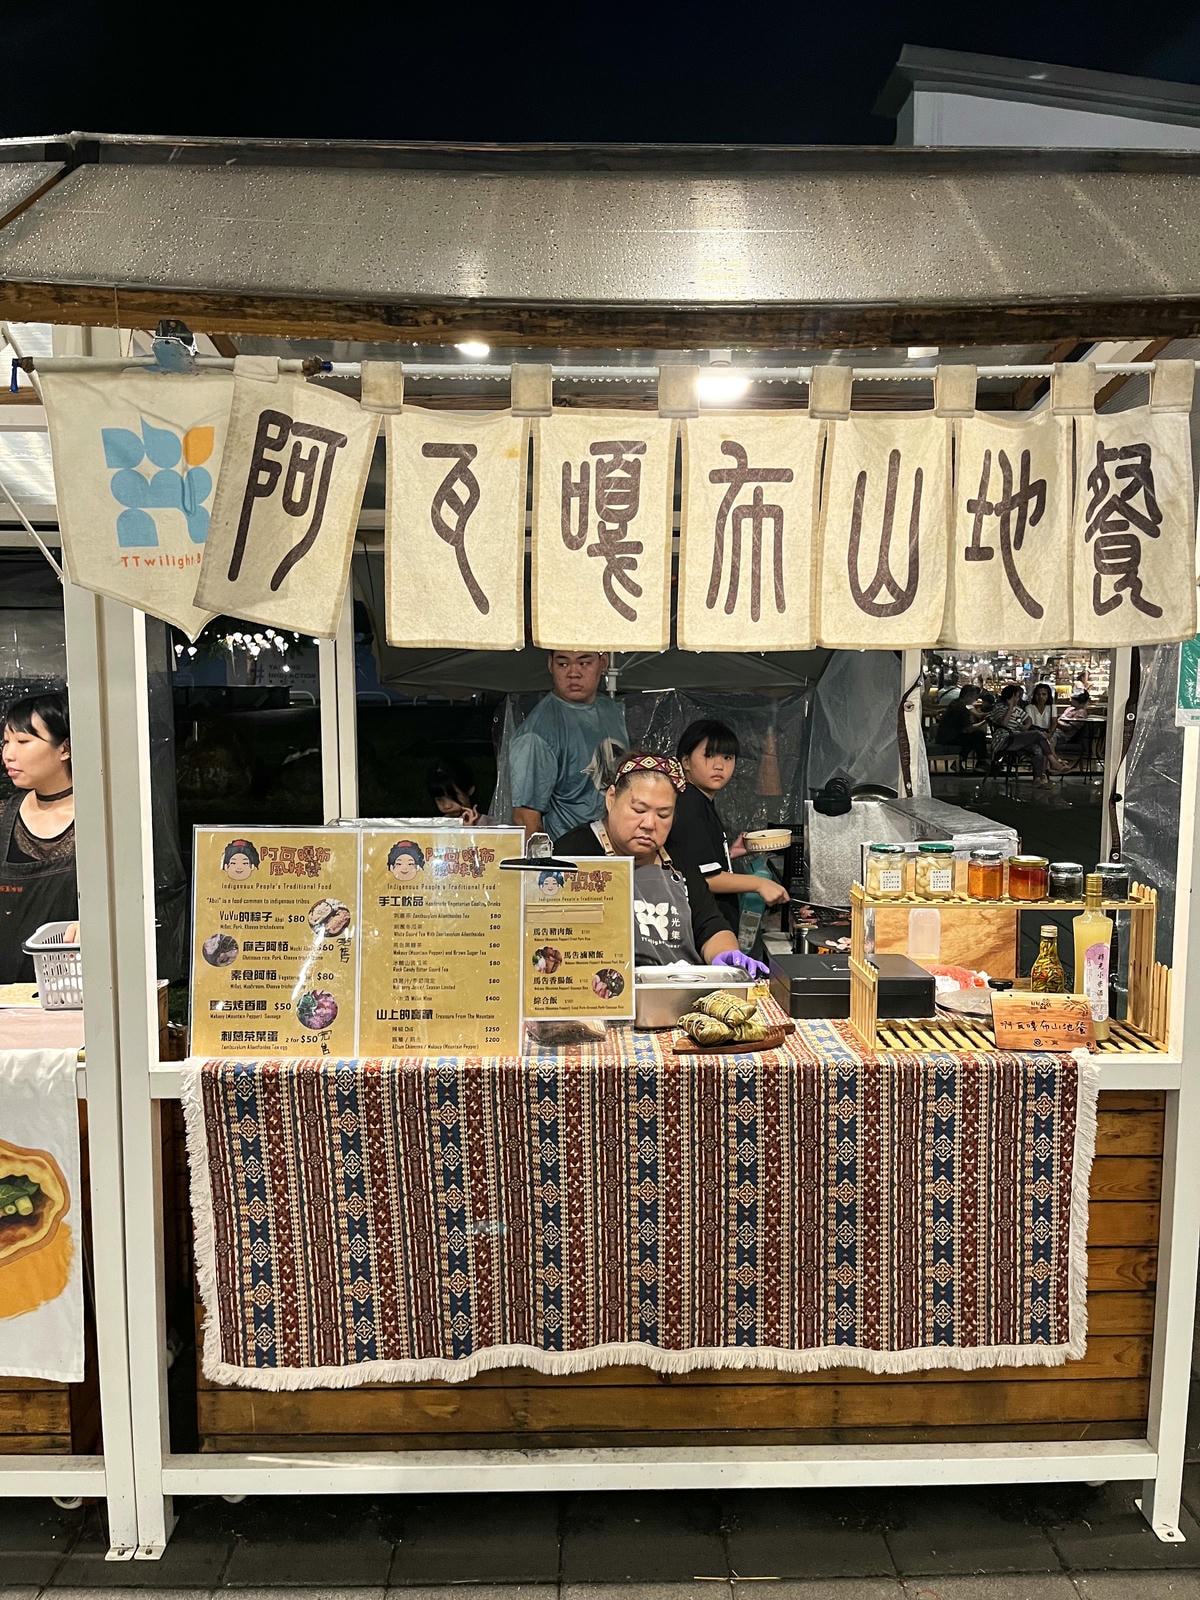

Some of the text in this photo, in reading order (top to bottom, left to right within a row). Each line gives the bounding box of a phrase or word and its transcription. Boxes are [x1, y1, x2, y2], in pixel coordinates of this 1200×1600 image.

[232, 897, 243, 905] food
[243, 897, 263, 905] common
[263, 897, 269, 905] to
[270, 897, 295, 905] indigenous
[378, 895, 424, 907] 手工飲品
[288, 914, 305, 923] $80
[317, 972, 334, 981] $80
[533, 996, 558, 1005] 綜合飯
[274, 1003, 291, 1011] $50
[300, 1035, 318, 1044] $50
